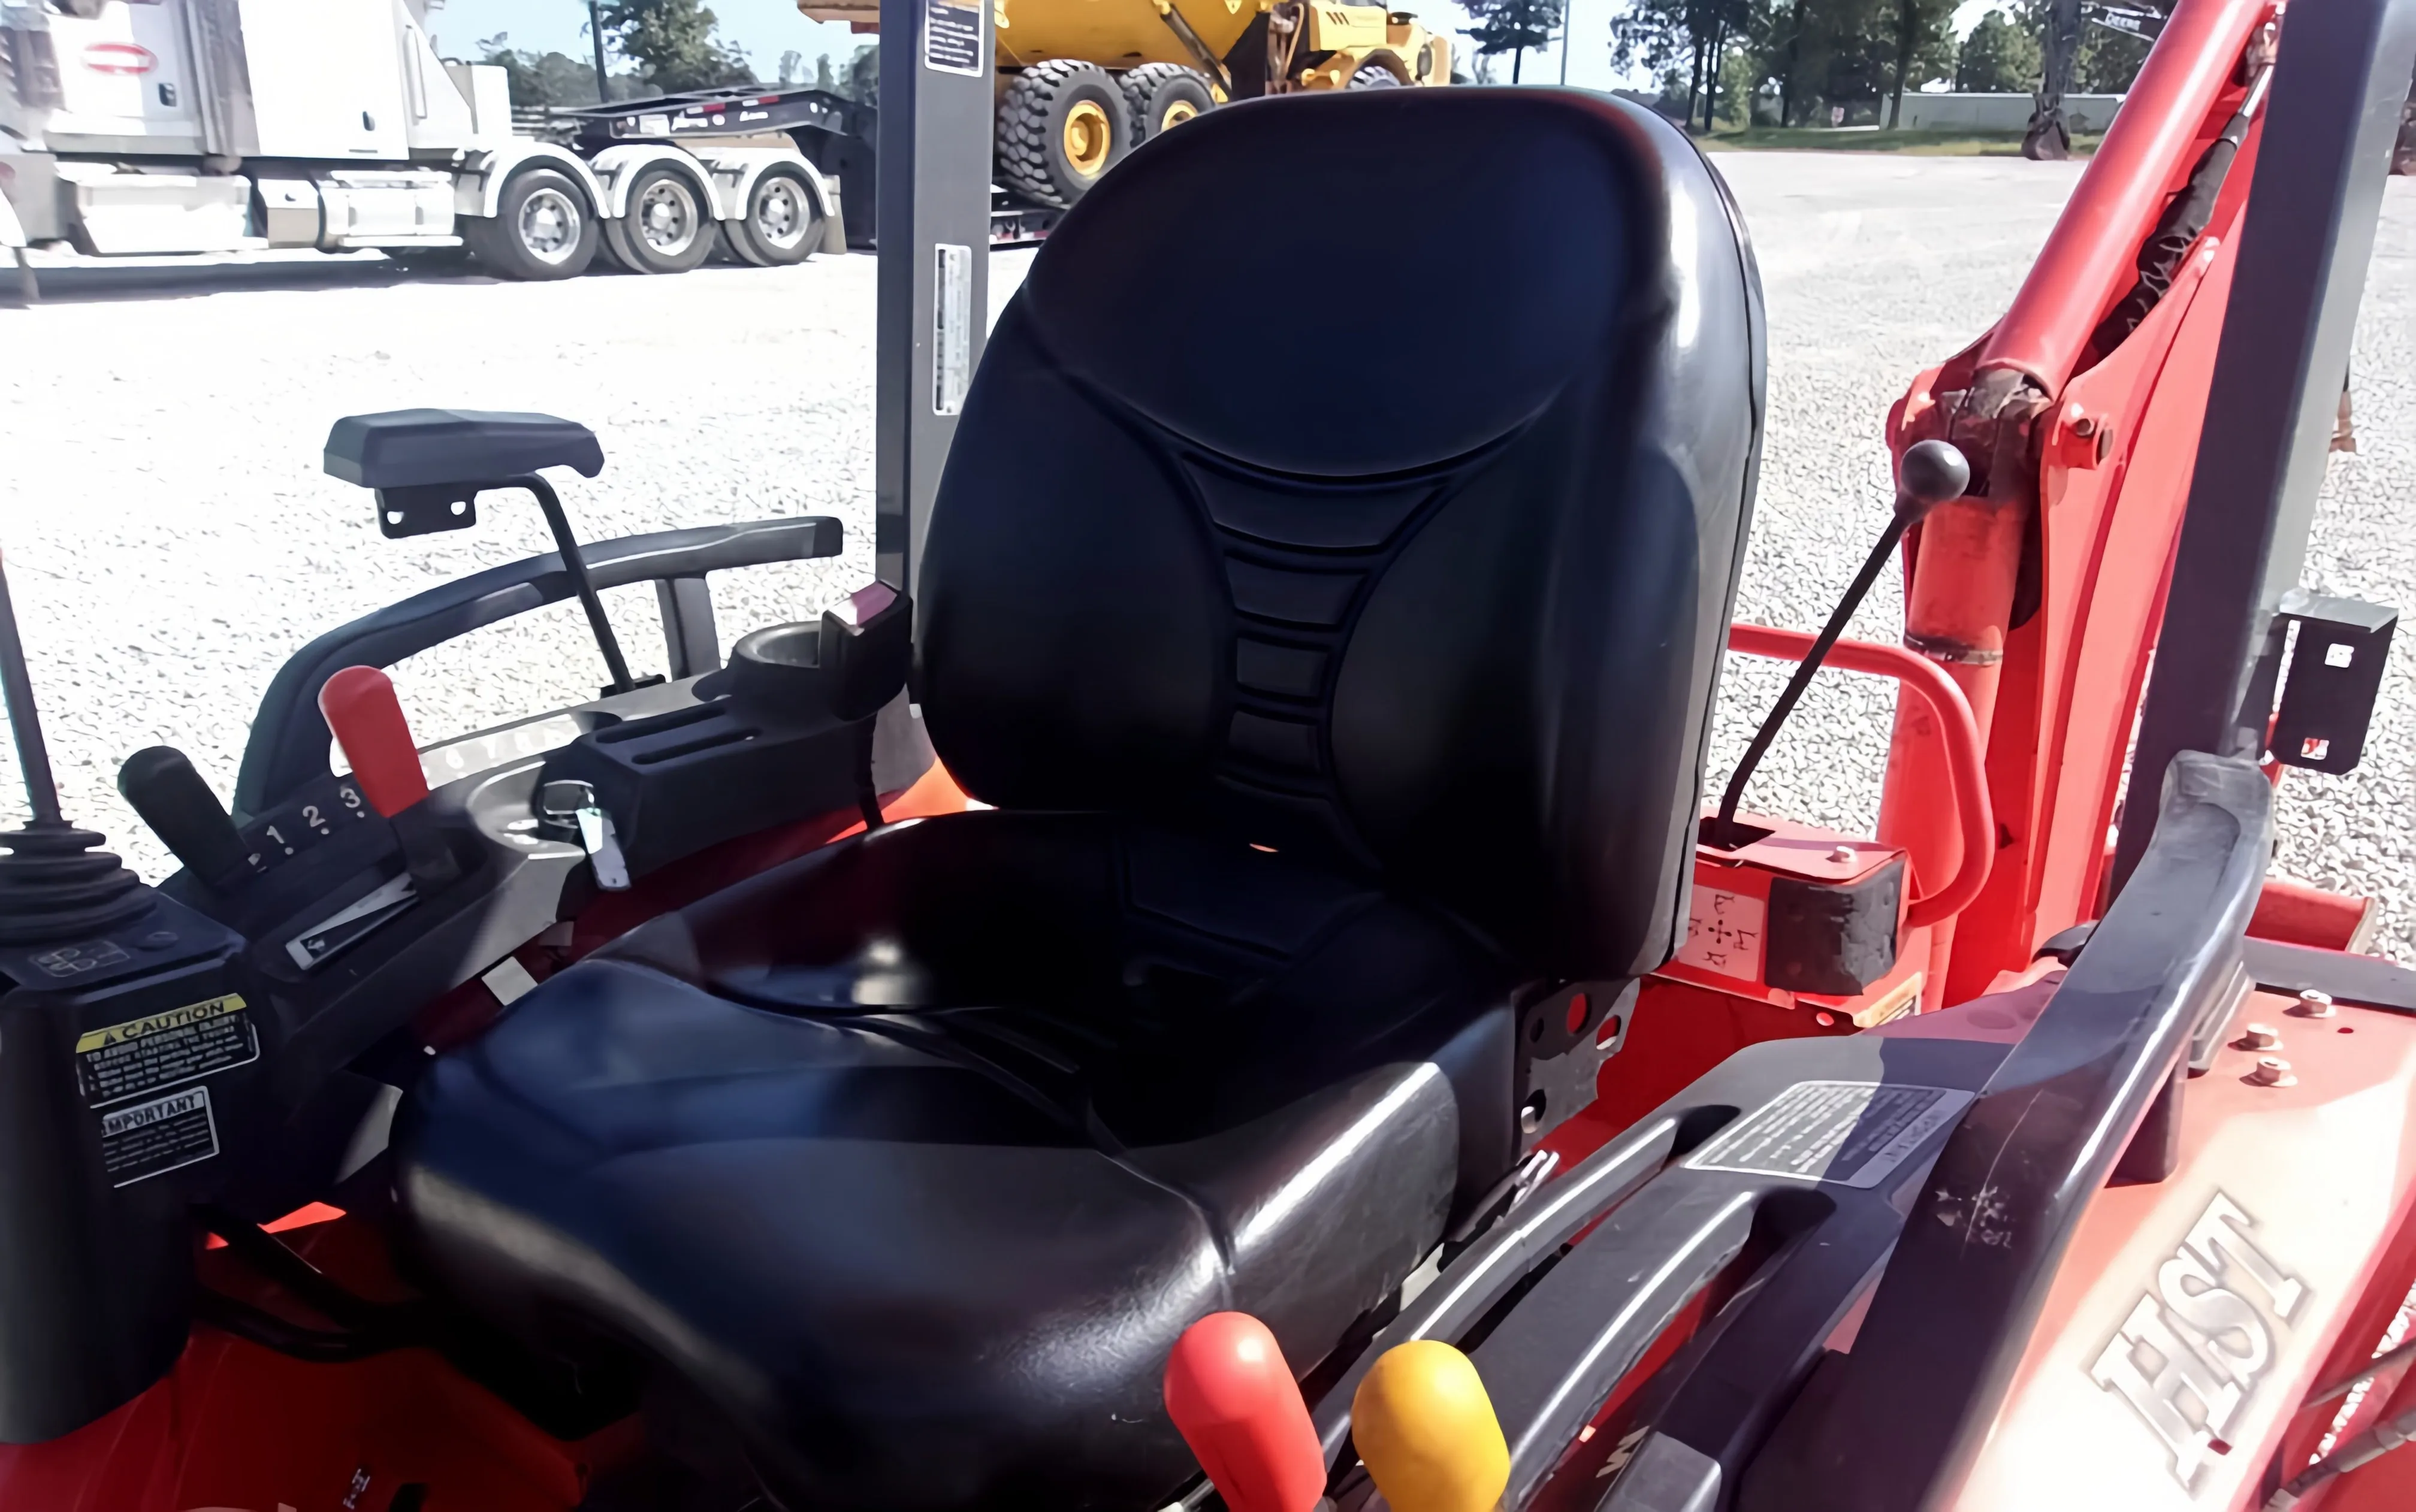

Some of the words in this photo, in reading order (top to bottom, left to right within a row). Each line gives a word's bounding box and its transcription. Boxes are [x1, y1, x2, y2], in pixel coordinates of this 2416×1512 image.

[267, 825, 285, 844] 1
[303, 806, 326, 827] 2
[340, 786, 361, 808] 3
[122, 1000, 225, 1039] CAUTION
[101, 1095, 195, 1136] IMPORTANT
[2086, 1188, 2311, 1495] HST
